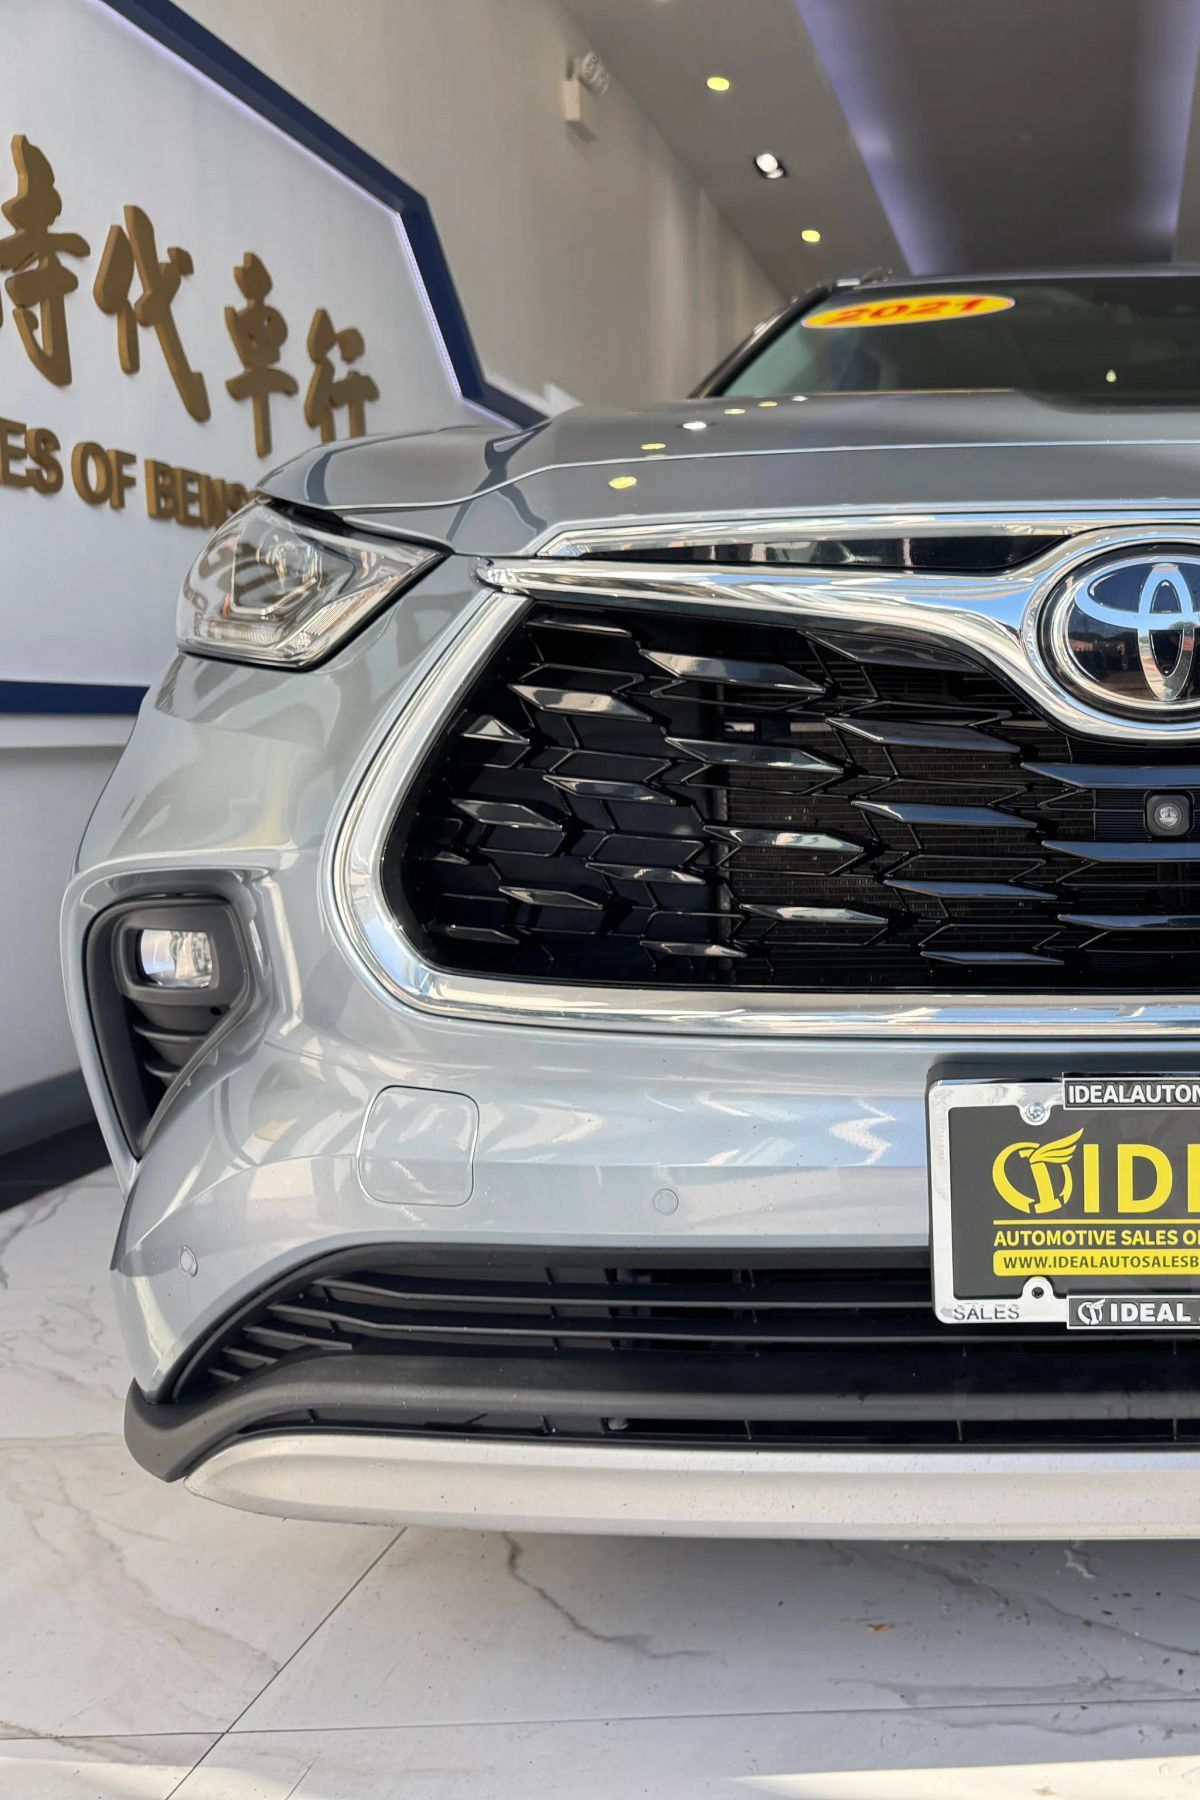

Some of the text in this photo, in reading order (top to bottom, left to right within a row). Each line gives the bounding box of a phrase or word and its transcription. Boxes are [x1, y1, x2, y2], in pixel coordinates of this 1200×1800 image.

[824, 297, 987, 325] 2021
[71, 441, 136, 510] OF
[993, 1230, 1116, 1246] AUTOMOTIVE
[1121, 1230, 1178, 1245] SALES
[953, 1304, 1020, 1320] SALES
[1110, 1303, 1190, 1322] IDEAL
